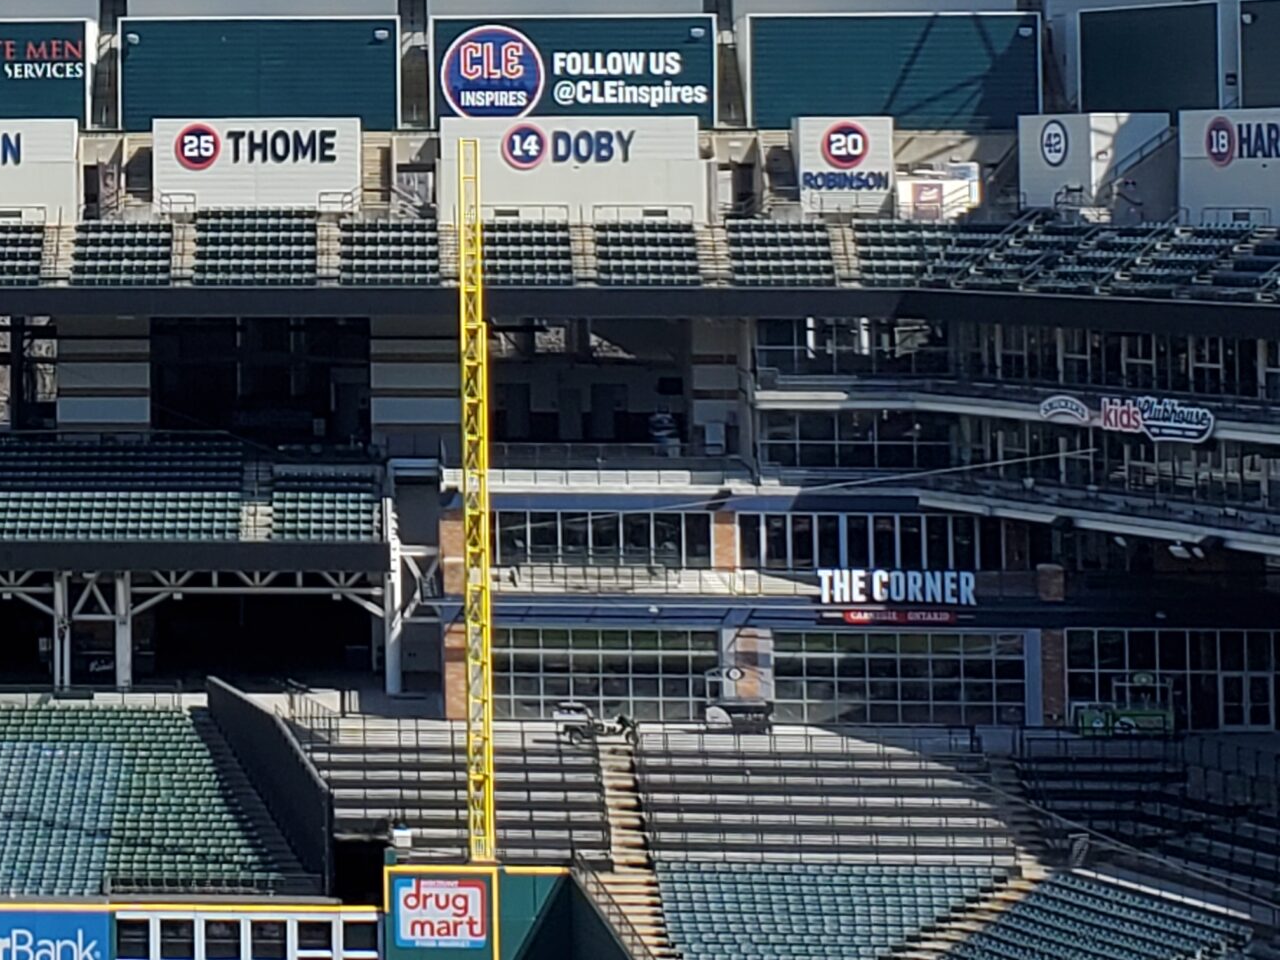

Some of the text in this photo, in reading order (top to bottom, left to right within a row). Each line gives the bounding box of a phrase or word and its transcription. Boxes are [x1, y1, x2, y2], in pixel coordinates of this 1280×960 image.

[4, 62, 84, 79] SERVICES
[460, 41, 524, 80] CLE
[553, 51, 682, 76] FOLLOW US
[460, 91, 528, 108] INSPIRES
[553, 80, 708, 108] @CLEinspires
[183, 129, 337, 164] 25 THOME
[512, 129, 636, 163] 14 DOBY
[830, 133, 864, 156] 20
[1044, 132, 1062, 154] 42
[1210, 130, 1228, 153] 18
[802, 171, 889, 191] ROBINSON
[1101, 398, 1143, 430] kids
[817, 568, 977, 606] THE CORNER
[403, 878, 470, 918] drug
[410, 915, 486, 938] mart
